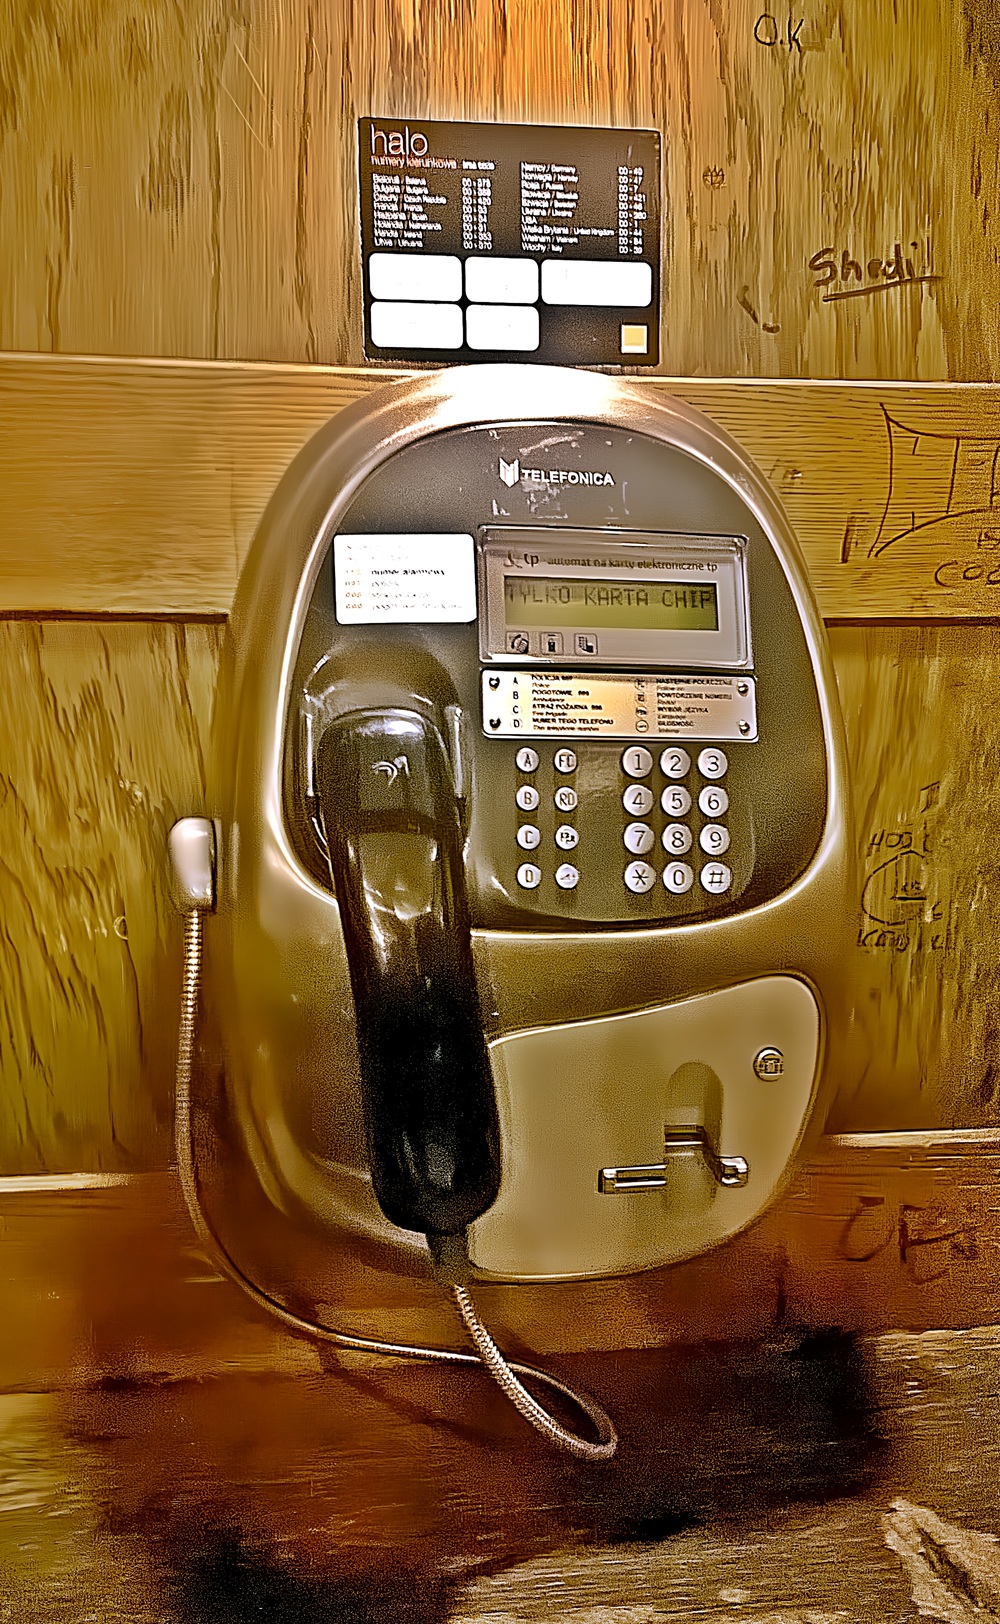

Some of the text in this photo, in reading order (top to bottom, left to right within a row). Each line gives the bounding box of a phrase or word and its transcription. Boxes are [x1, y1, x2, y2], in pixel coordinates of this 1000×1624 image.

[370, 123, 428, 156] halo
[521, 468, 615, 487] TELEFONICA
[523, 553, 540, 567] tp
[637, 558, 704, 571] elektroniczne
[706, 562, 718, 573] tp
[506, 583, 712, 609] TYLKO KARTA CHIP
[513, 677, 518, 685] A
[513, 691, 519, 700] B
[512, 705, 519, 714] C
[513, 719, 520, 728] D
[524, 754, 532, 767] A
[634, 754, 642, 771] 1
[670, 755, 682, 771] 2
[707, 756, 719, 772] 3
[524, 792, 532, 805] B
[632, 792, 645, 807] 4
[671, 793, 682, 809] 5
[708, 793, 720, 810] 6
[525, 831, 533, 844] C
[635, 831, 646, 847] 7
[671, 831, 684, 848] 8
[709, 831, 722, 848] 9
[673, 870, 685, 886] 0
